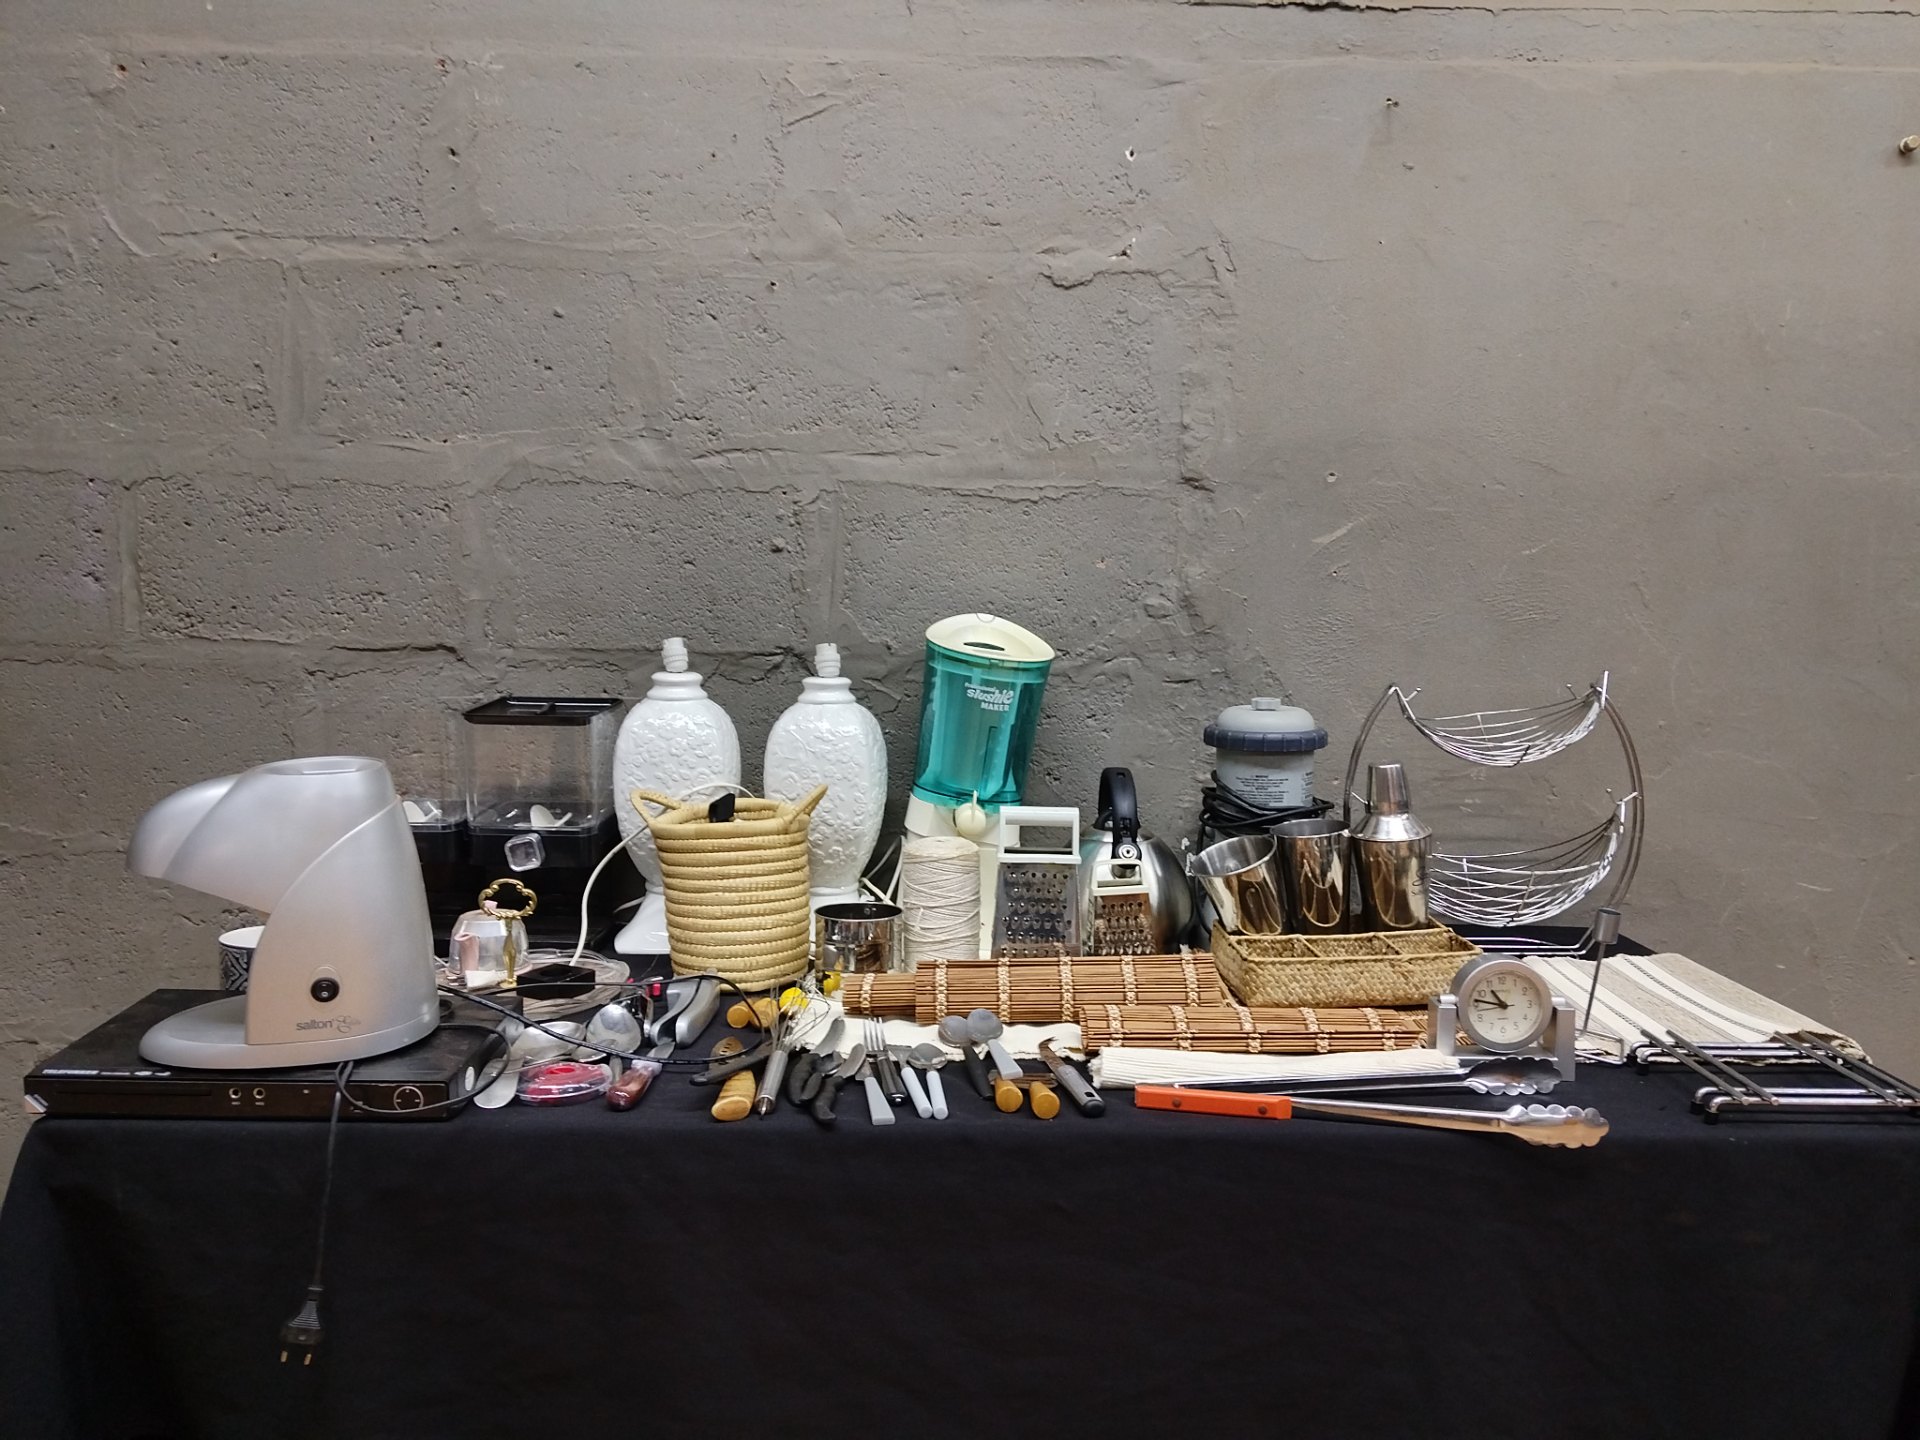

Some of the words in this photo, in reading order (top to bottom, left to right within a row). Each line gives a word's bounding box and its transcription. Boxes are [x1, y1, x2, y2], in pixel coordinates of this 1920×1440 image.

[981, 702, 1009, 711] MAKER
[1477, 989, 1487, 998] 10
[1527, 999, 1533, 1009] 3
[296, 1018, 333, 1031] salton
